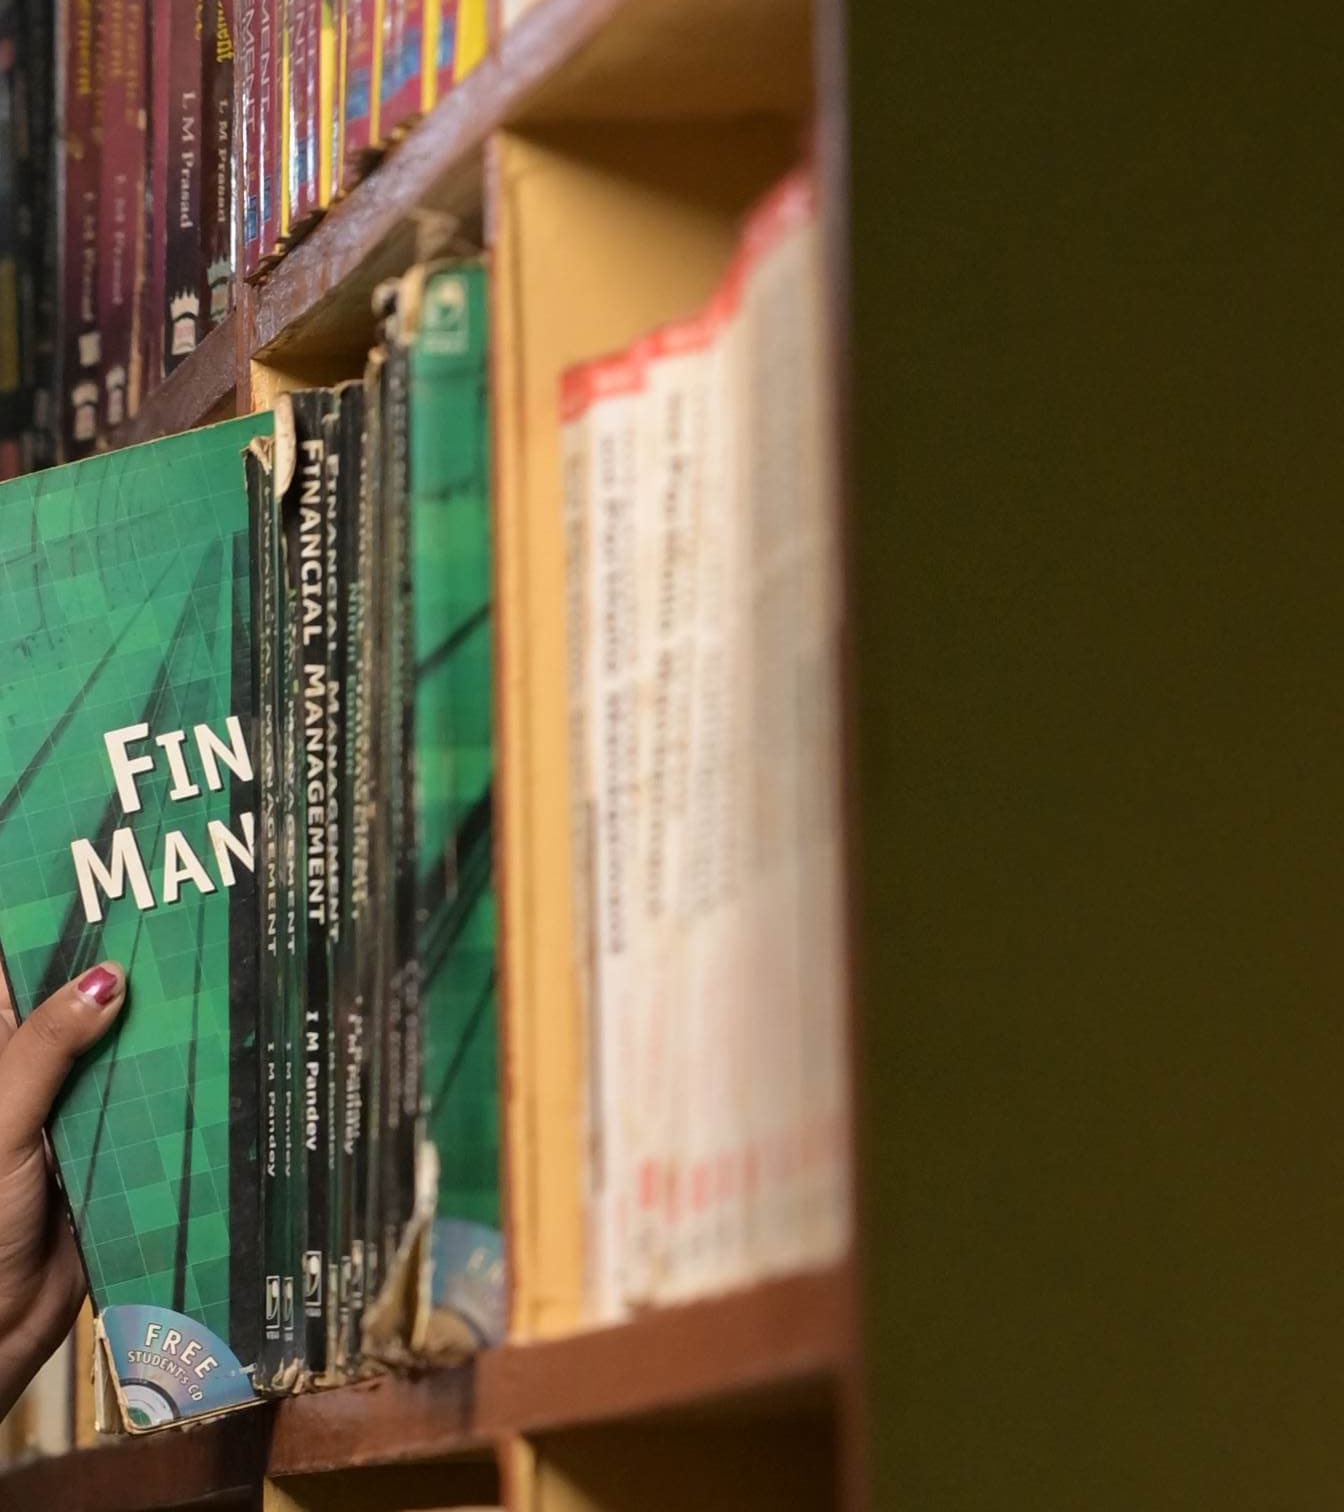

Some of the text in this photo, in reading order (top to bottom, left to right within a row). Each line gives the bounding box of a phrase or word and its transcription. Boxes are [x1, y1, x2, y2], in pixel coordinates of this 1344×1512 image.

[181, 122, 195, 143] M
[217, 120, 227, 140] M
[180, 152, 195, 229] Prasad
[299, 438, 326, 926] FINANCIAL MANAGEMENT
[326, 453, 340, 944] FINANCIAL MANAGEMENT
[103, 716, 254, 814] FIN
[70, 811, 255, 924] MAN
[265, 704, 278, 957] MANAGEMENT
[267, 1062, 276, 1081] M
[285, 1061, 293, 1080] M
[305, 1010, 320, 1152] I M Pandey
[267, 1090, 278, 1178] Pandey
[127, 1350, 204, 1401] STUDENT'S CD
[144, 1322, 219, 1379] FREE
